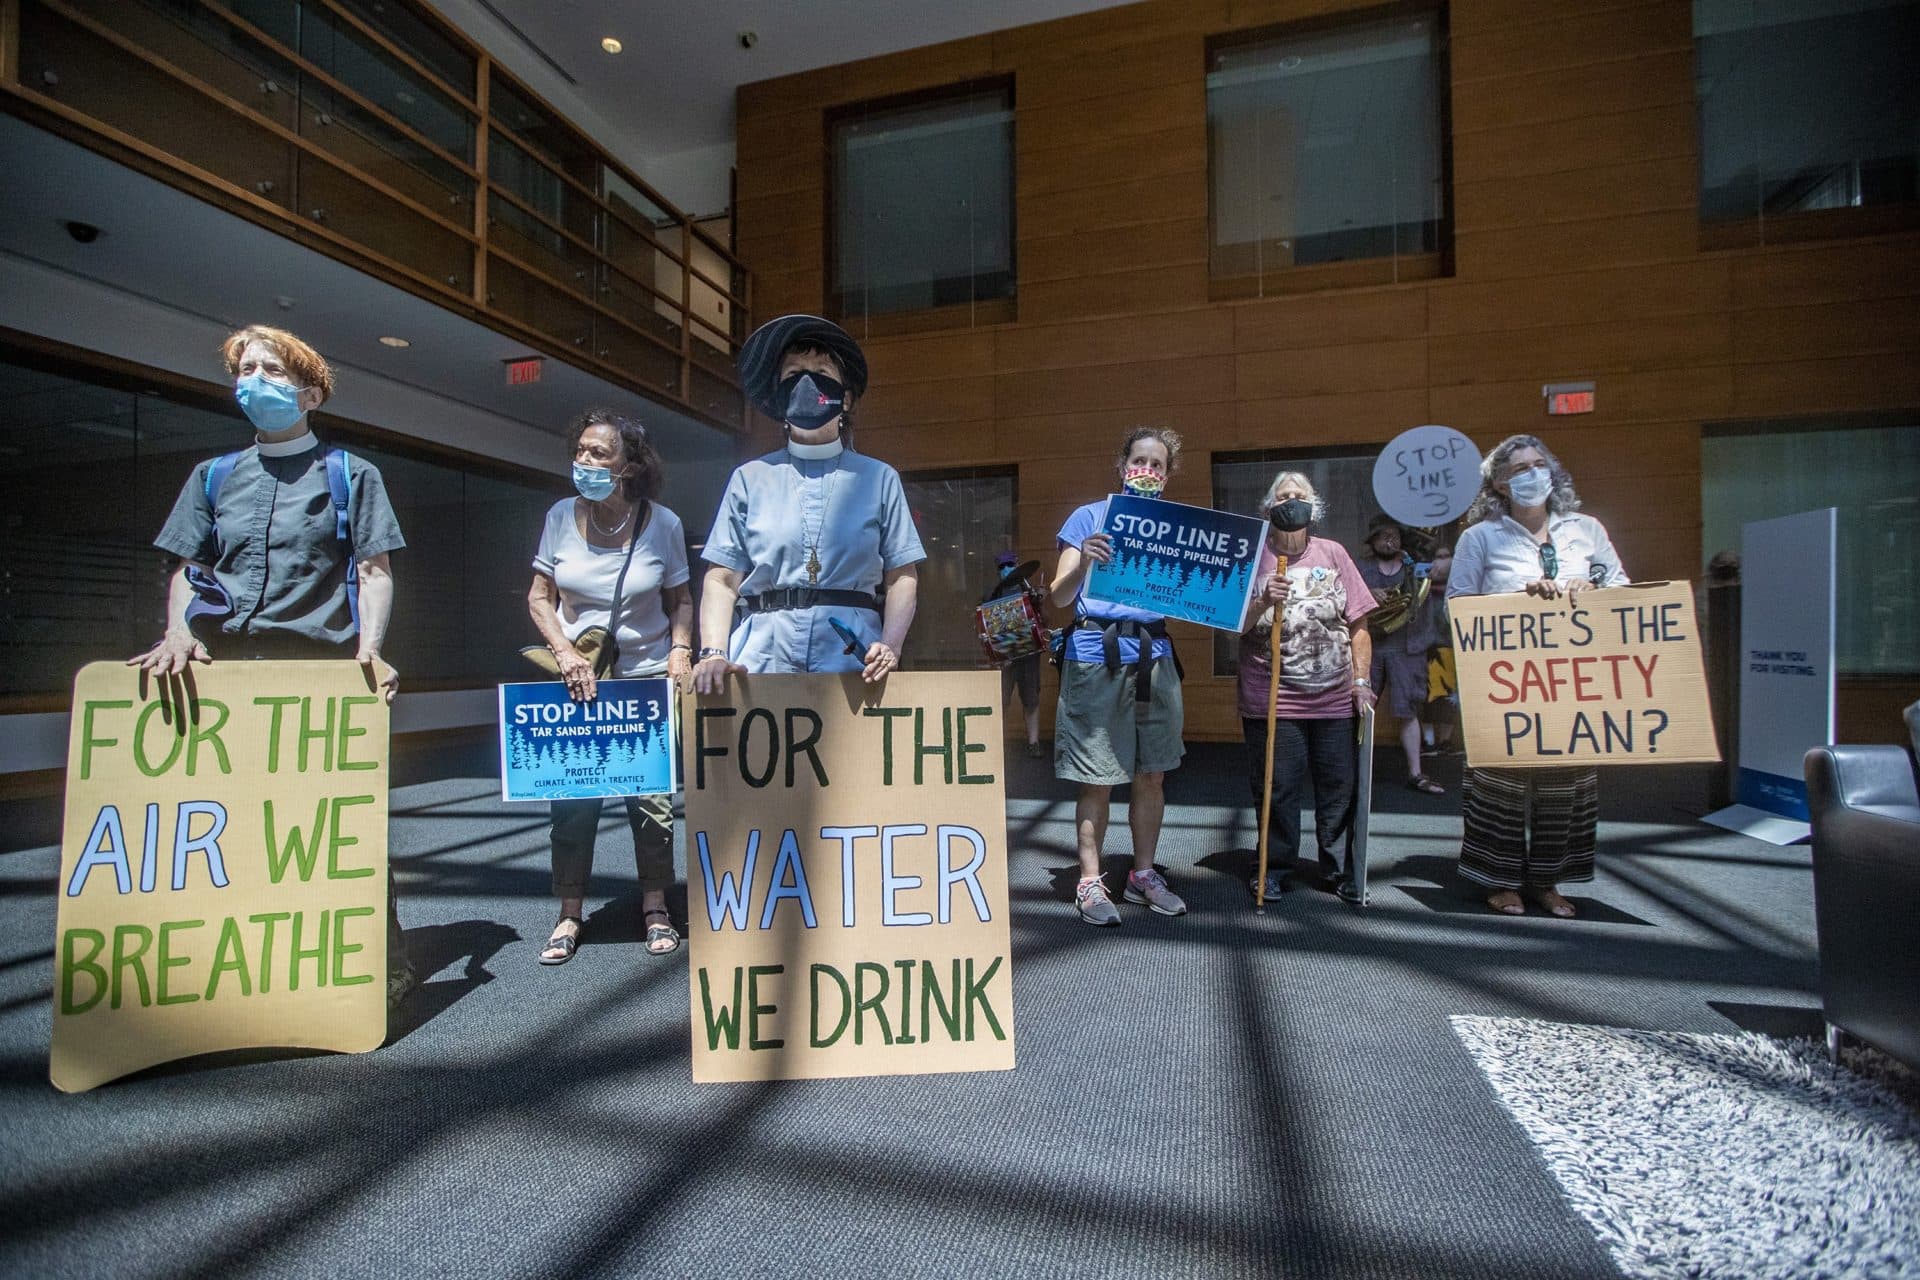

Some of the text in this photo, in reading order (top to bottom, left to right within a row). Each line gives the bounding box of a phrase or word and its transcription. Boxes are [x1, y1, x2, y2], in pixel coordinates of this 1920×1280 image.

[512, 361, 537, 384] EXIT
[1396, 437, 1466, 477] STOP
[1408, 468, 1456, 491] LINE
[1423, 493, 1450, 517] 3
[1111, 513, 1249, 559] STOP LINE 3
[1123, 536, 1230, 568] TAR SANDS PIPELINE
[1115, 585, 1145, 598] CLIMATE
[1152, 595, 1175, 605] WATER
[1184, 601, 1216, 615] TREATIES
[1145, 582, 1184, 598] PROTECT
[1454, 603, 1686, 652] WHERE'S THE
[1750, 650, 1807, 662] THANK YOU
[1750, 663, 1769, 673] FOR
[1488, 654, 1659, 704] SAFETY
[515, 700, 660, 725] STOP LINE 3
[80, 696, 379, 780] FOR THE
[530, 723, 646, 738] TAR SANDS PIPELINE
[1504, 709, 1668, 756] PLAN?
[695, 706, 995, 790] FOR THE
[534, 775, 645, 788] CLIMATE WATER TREATIES
[565, 766, 607, 777] PROTECT
[67, 795, 376, 897] AIR WE
[695, 823, 992, 932] WATER
[61, 907, 376, 1016] BREATHE
[698, 956, 1007, 1051] WE DRINK
